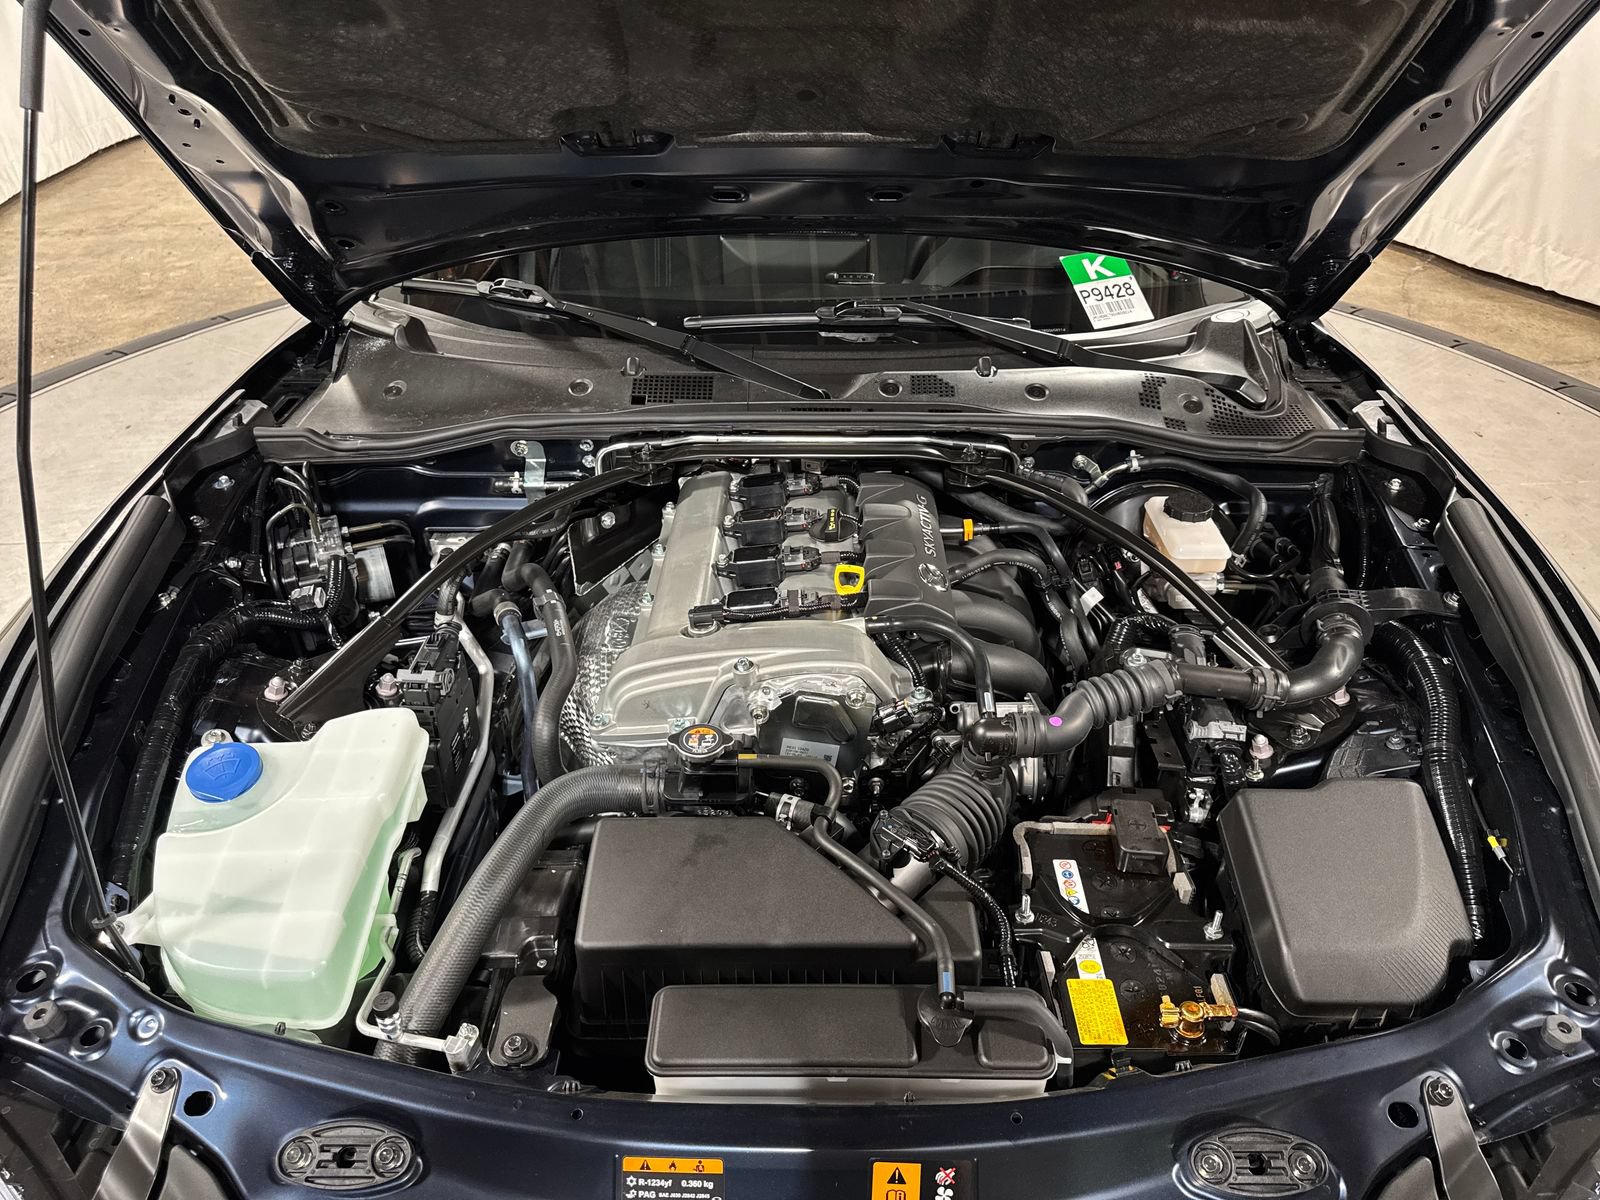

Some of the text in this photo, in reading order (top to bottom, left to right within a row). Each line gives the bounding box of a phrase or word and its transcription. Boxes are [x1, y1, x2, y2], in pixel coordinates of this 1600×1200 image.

[1081, 254, 1116, 280] K
[1079, 282, 1135, 304] P9428
[916, 493, 937, 557] SKYACTIV-G
[638, 1178, 672, 1188] R-1234yf
[703, 1180, 714, 1189] kg
[638, 1190, 656, 1198] PAG
